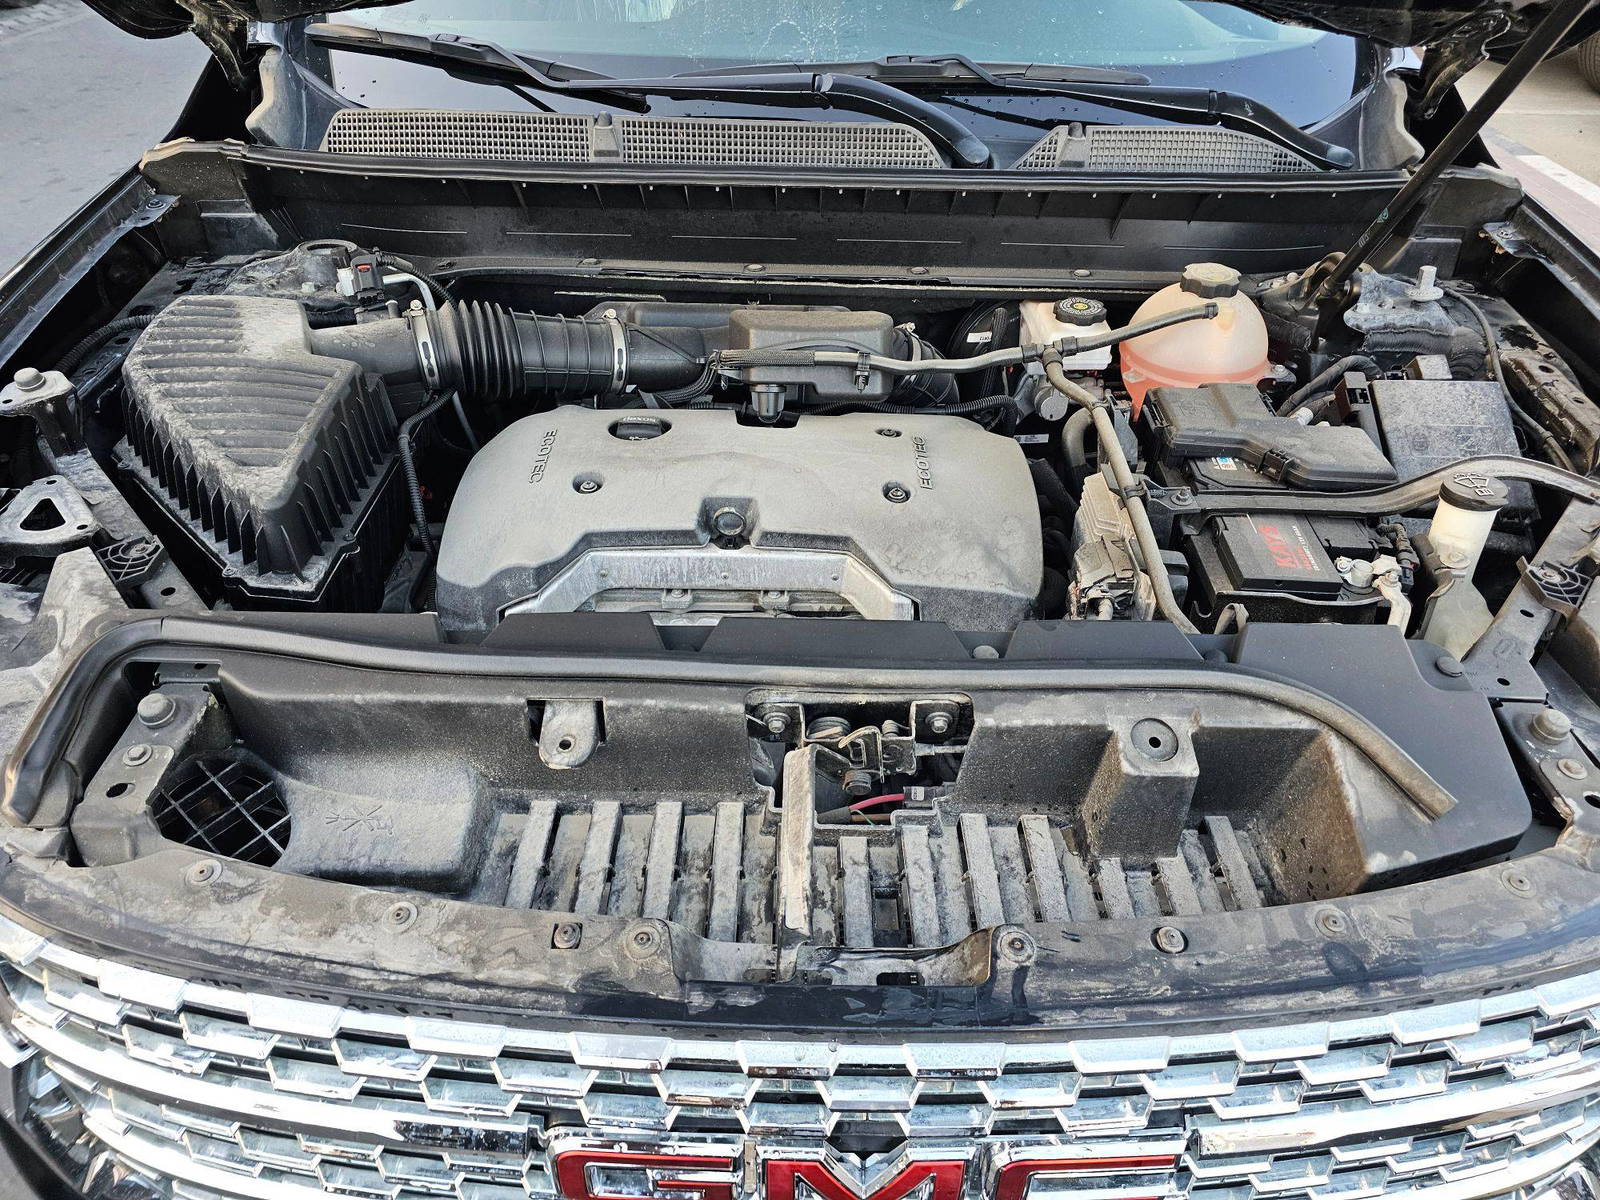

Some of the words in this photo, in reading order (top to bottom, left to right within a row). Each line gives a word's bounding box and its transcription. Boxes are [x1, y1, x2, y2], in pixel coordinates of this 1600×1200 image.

[528, 429, 558, 484] ECOTEC
[912, 435, 933, 490] ECOTEC
[551, 1145, 1181, 1200] GMC
